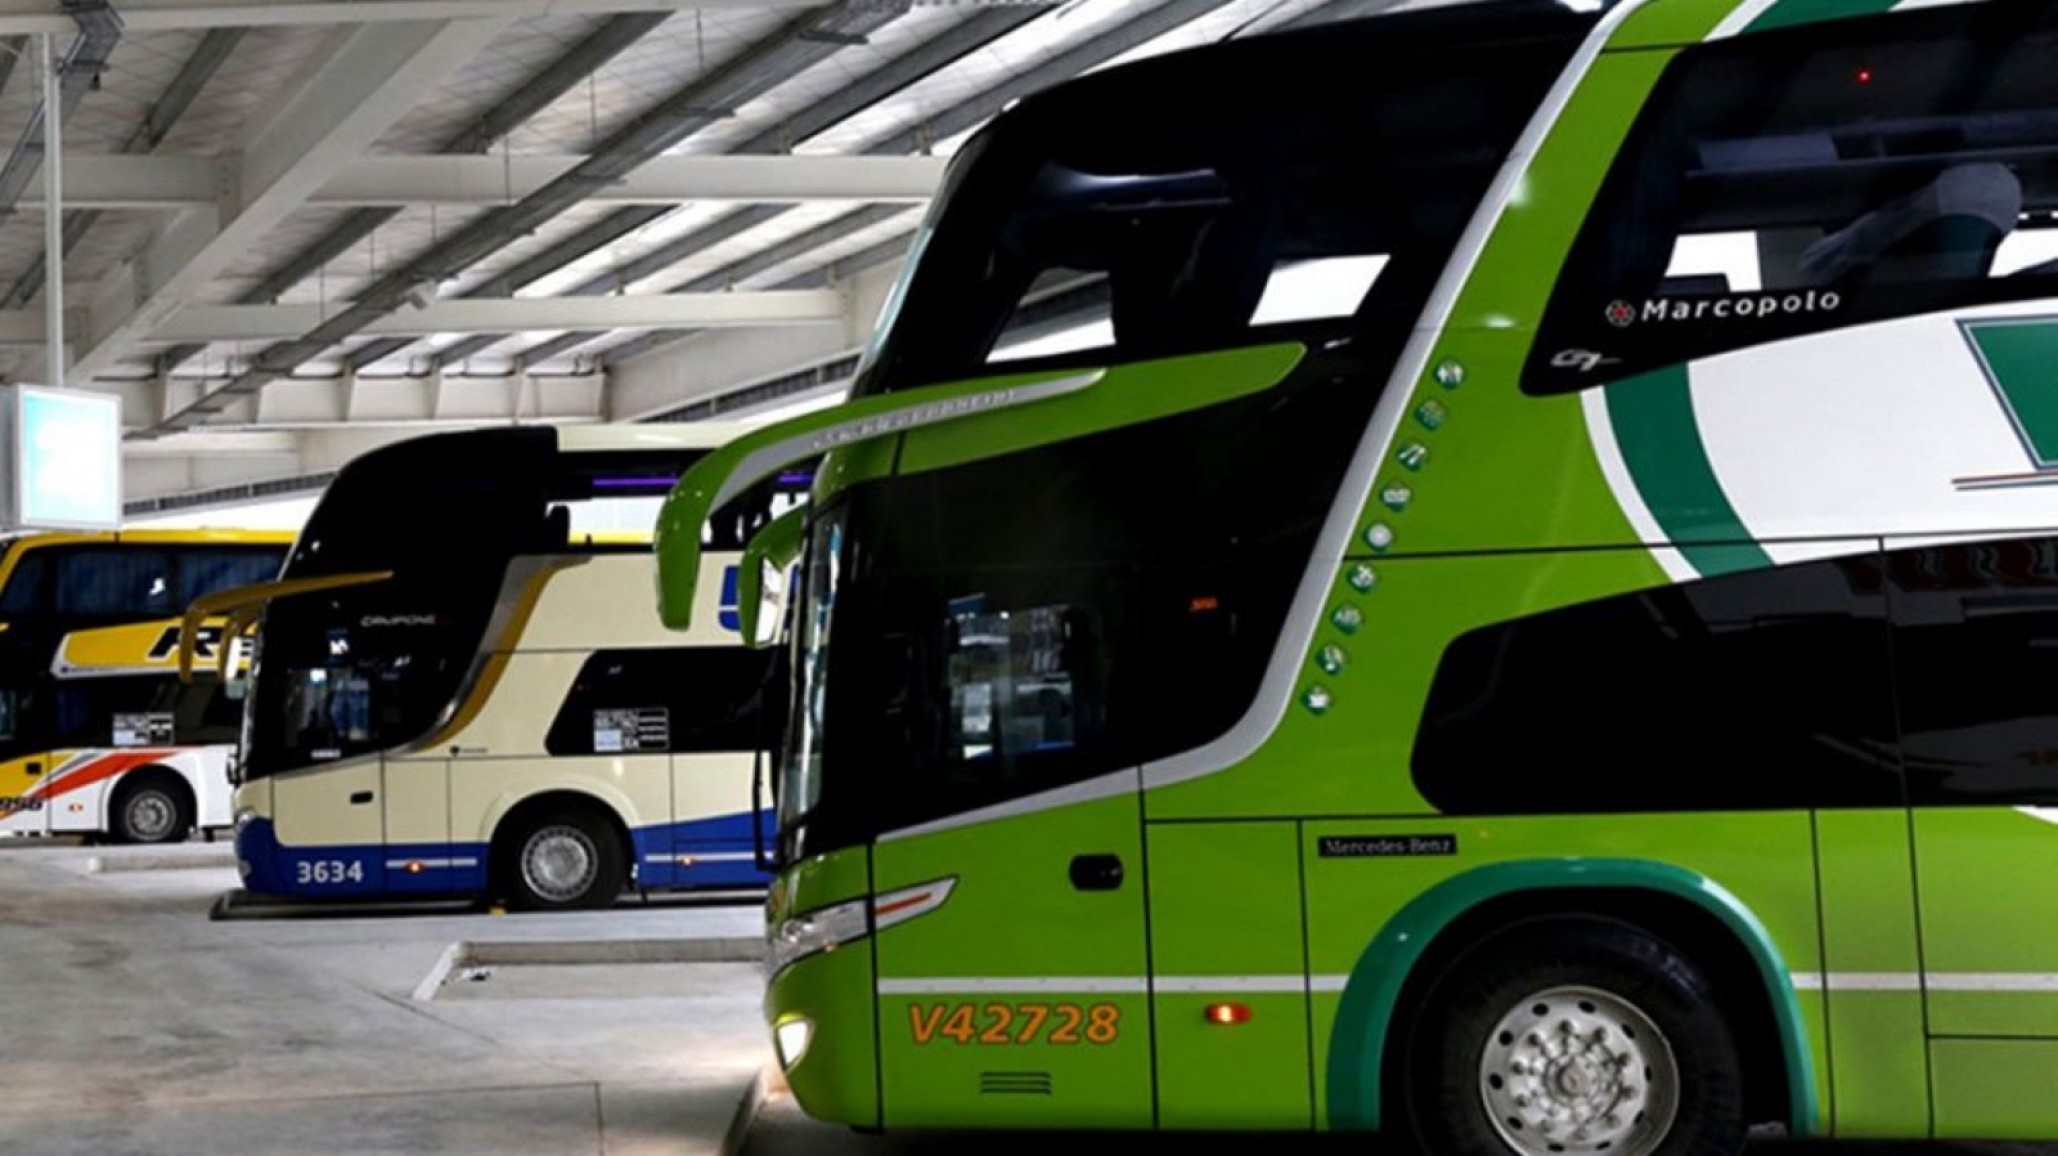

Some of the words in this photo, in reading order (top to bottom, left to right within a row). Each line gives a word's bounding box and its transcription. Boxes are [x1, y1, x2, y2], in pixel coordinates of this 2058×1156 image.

[1641, 290, 1840, 322] Marcopolo
[296, 860, 364, 884] 3634
[908, 1001, 1121, 1045] V42728
